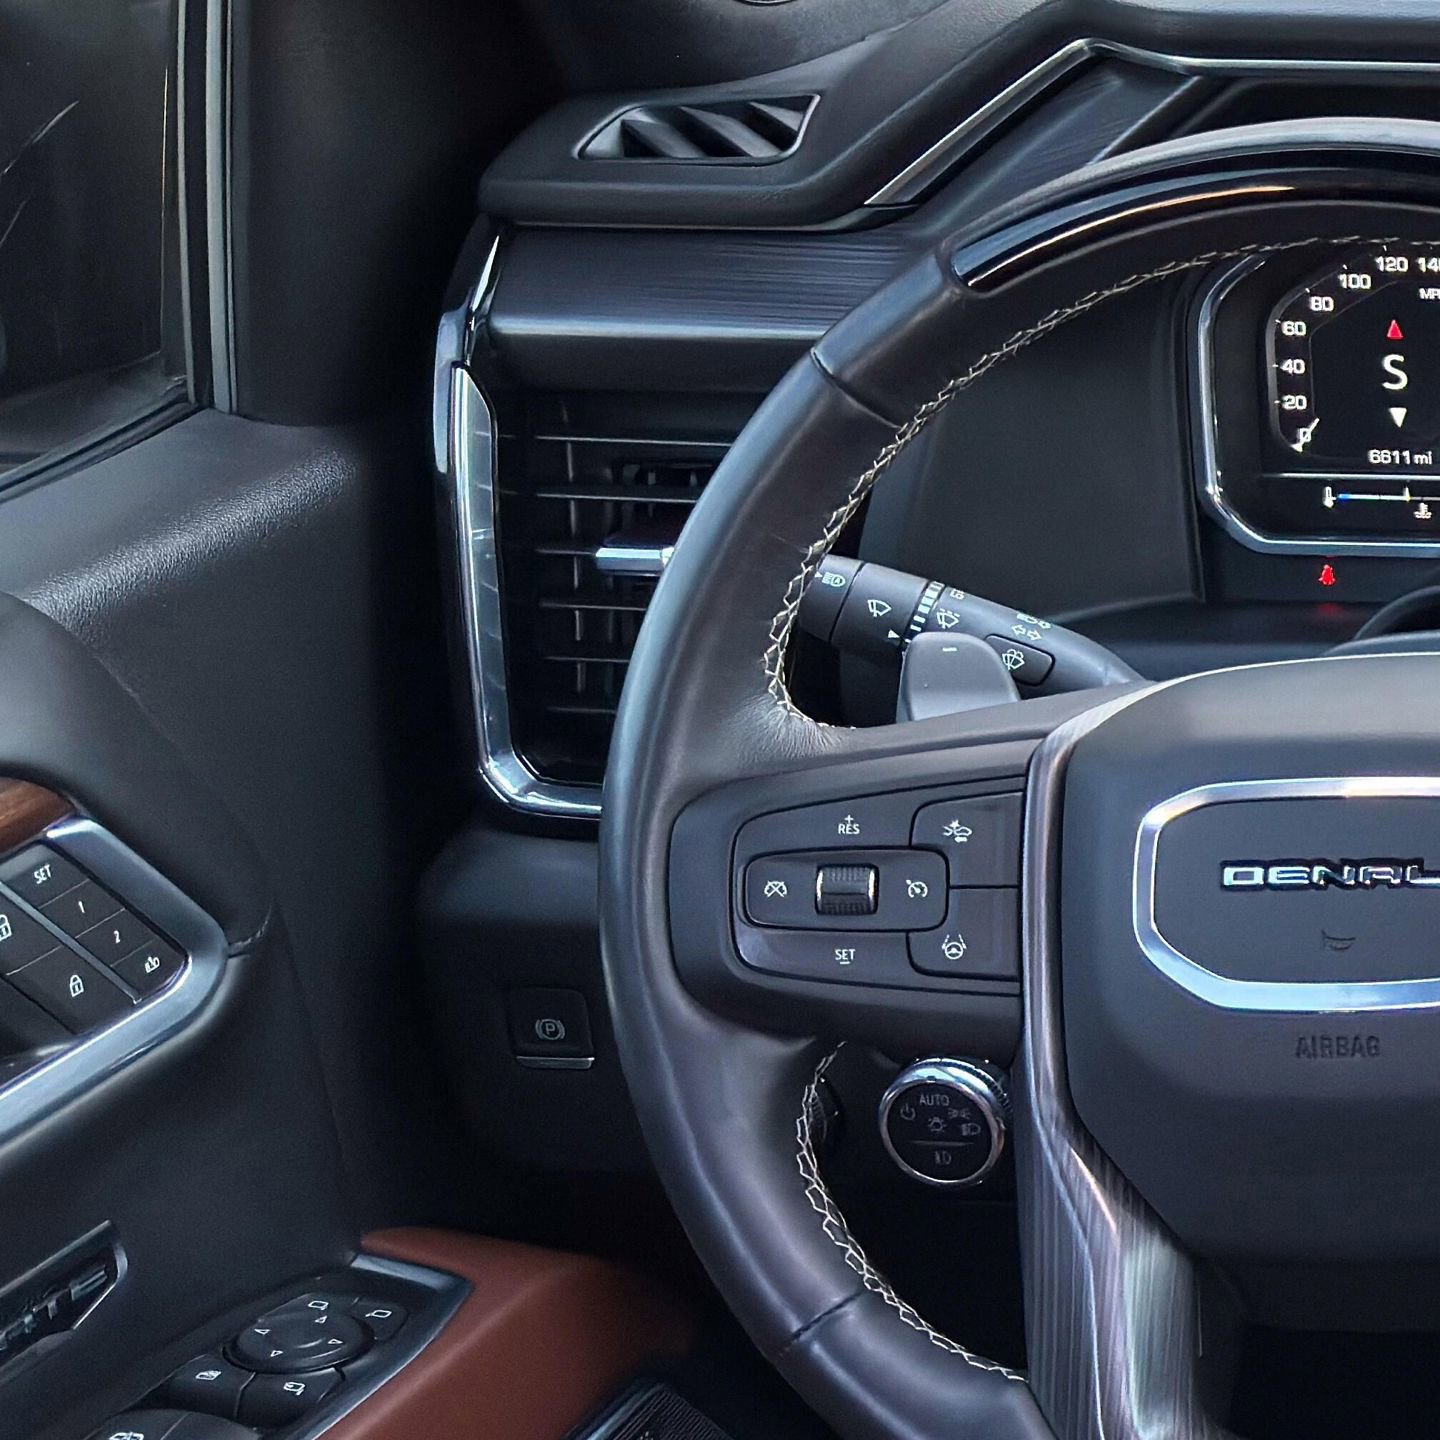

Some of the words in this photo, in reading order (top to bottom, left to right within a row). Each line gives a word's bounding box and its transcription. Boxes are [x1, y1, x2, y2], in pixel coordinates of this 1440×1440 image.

[1376, 256, 1409, 273] 120
[1338, 273, 1372, 290] 100
[1309, 295, 1335, 312] 80
[1281, 320, 1308, 337] 60
[1281, 359, 1306, 375] 40
[1381, 354, 1409, 391] S
[1282, 395, 1308, 411] 20
[1368, 449, 1411, 465] 6611
[1413, 450, 1434, 466] mi
[837, 823, 861, 836] RES
[33, 863, 52, 885] SET
[77, 900, 86, 914] 1
[113, 929, 121, 945] 2
[834, 948, 857, 961] SET
[1294, 1035, 1382, 1060] AIRBAG
[919, 1093, 951, 1107] AUTO
